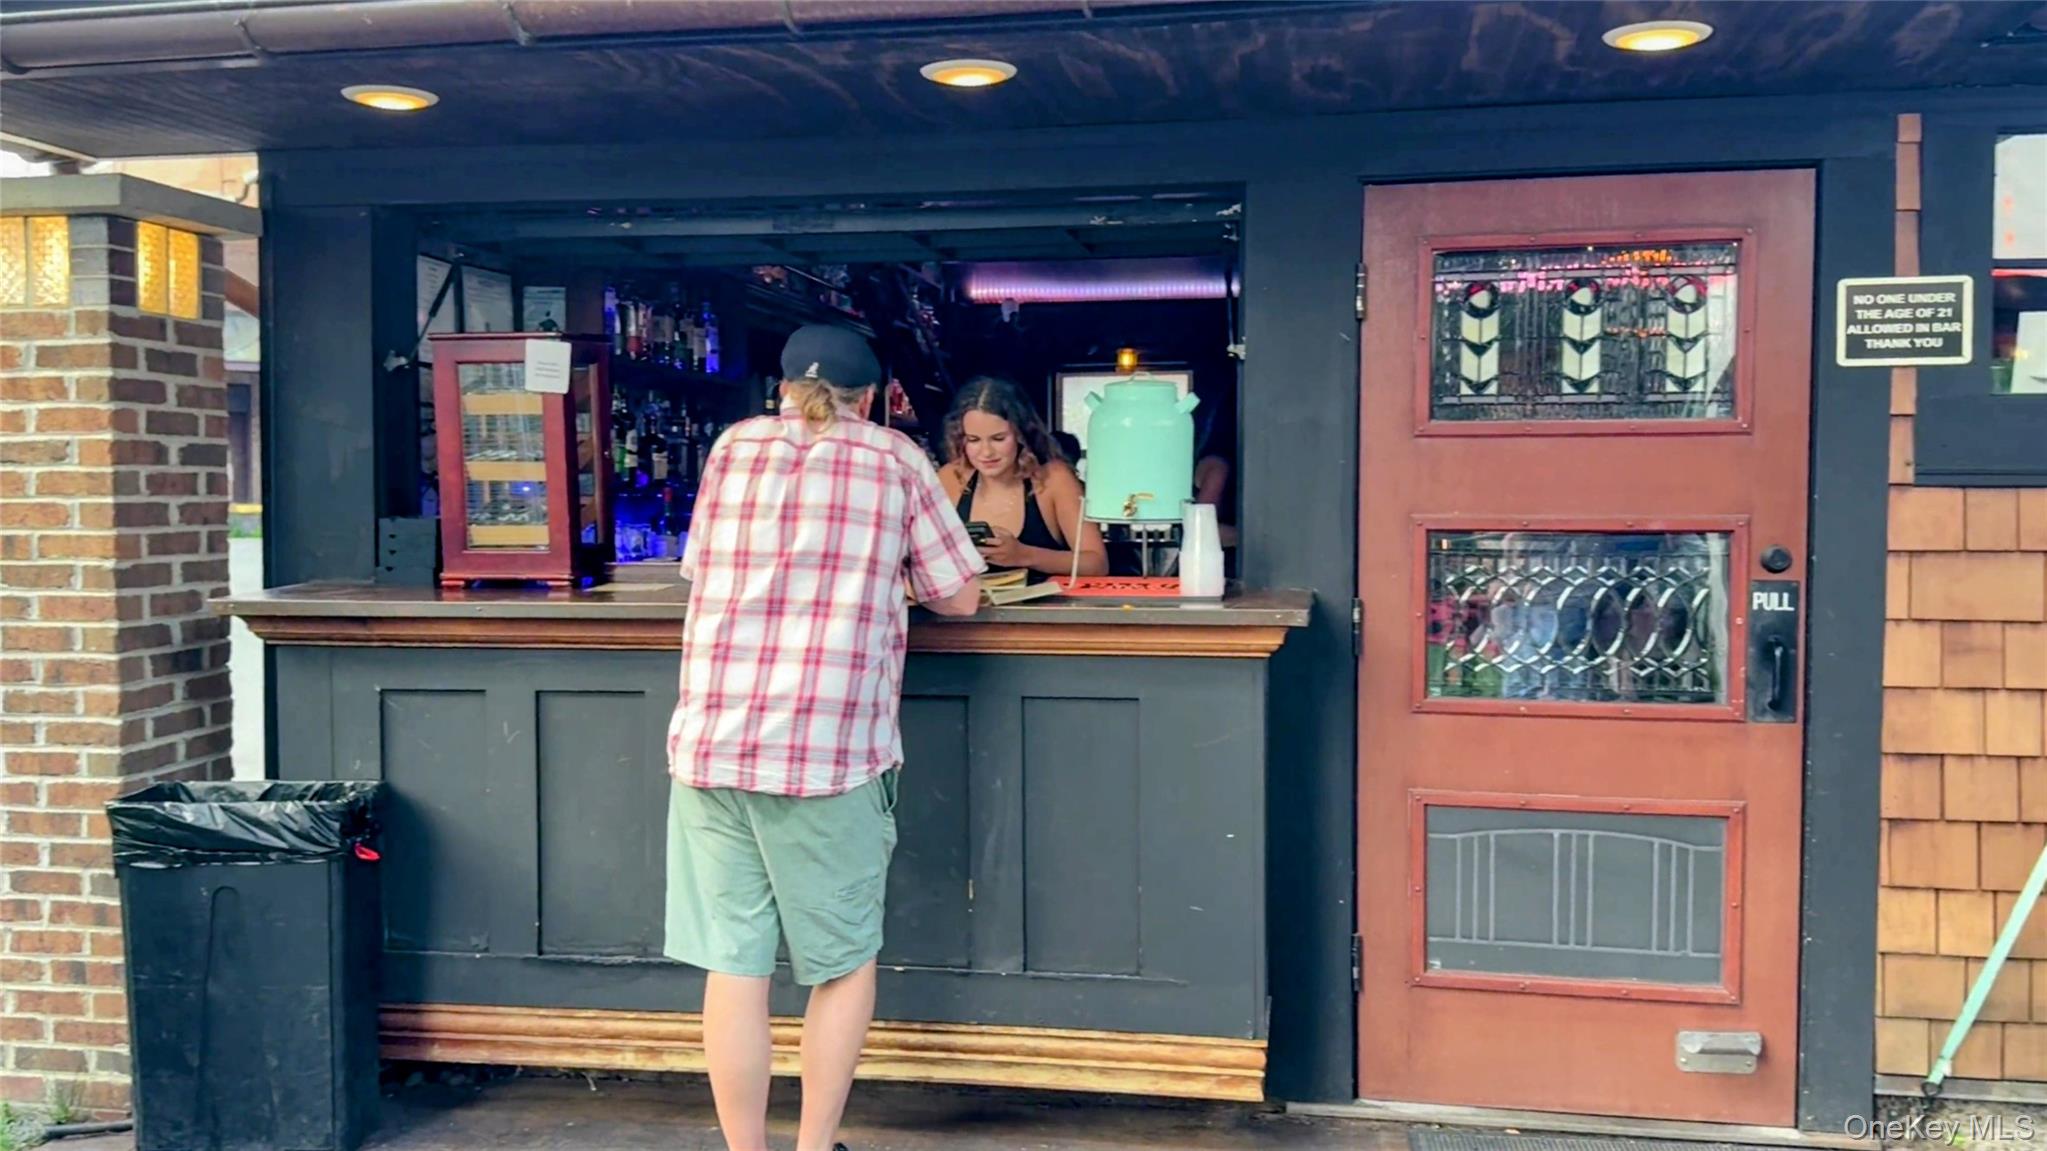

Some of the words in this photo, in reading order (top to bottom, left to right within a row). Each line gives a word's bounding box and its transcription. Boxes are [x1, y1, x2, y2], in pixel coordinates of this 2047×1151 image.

[1853, 295, 1874, 305] NO
[1876, 294, 1906, 304] ONE
[1908, 292, 1956, 303] UNDER
[1855, 309, 1882, 320] THE
[1884, 308, 1914, 319] AGE
[1915, 307, 1936, 318] OF
[1937, 307, 1953, 317] 21
[1846, 323, 1913, 334] ALLOWED
[1915, 322, 1930, 333] IN
[1932, 322, 1961, 332] BAR
[1864, 338, 1912, 349] THANK
[1913, 337, 1943, 348] YOU
[1752, 592, 1795, 611] PULL
